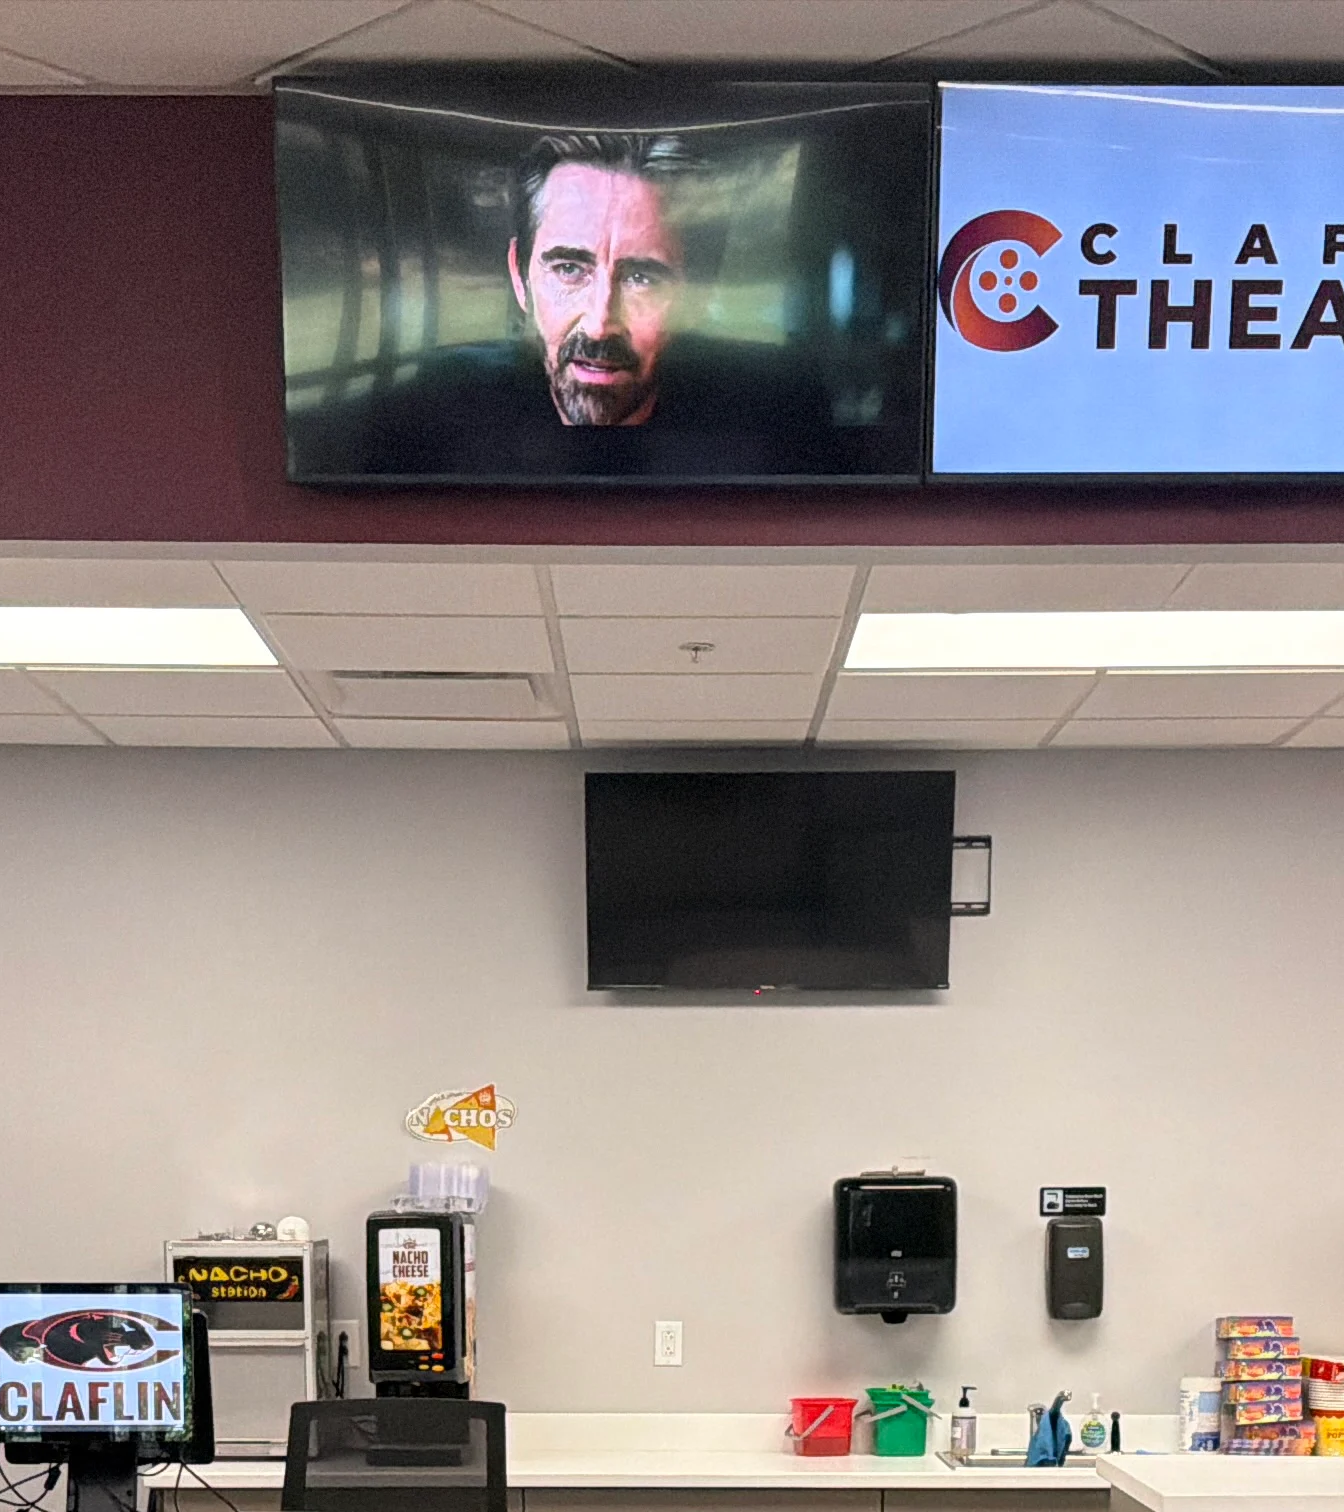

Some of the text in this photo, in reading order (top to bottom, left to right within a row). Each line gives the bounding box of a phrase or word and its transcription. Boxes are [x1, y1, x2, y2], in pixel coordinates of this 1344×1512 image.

[392, 1250, 429, 1264] NACHO
[188, 1266, 288, 1282] NACHO
[392, 1265, 429, 1278] CHEESE
[211, 1285, 267, 1298] station
